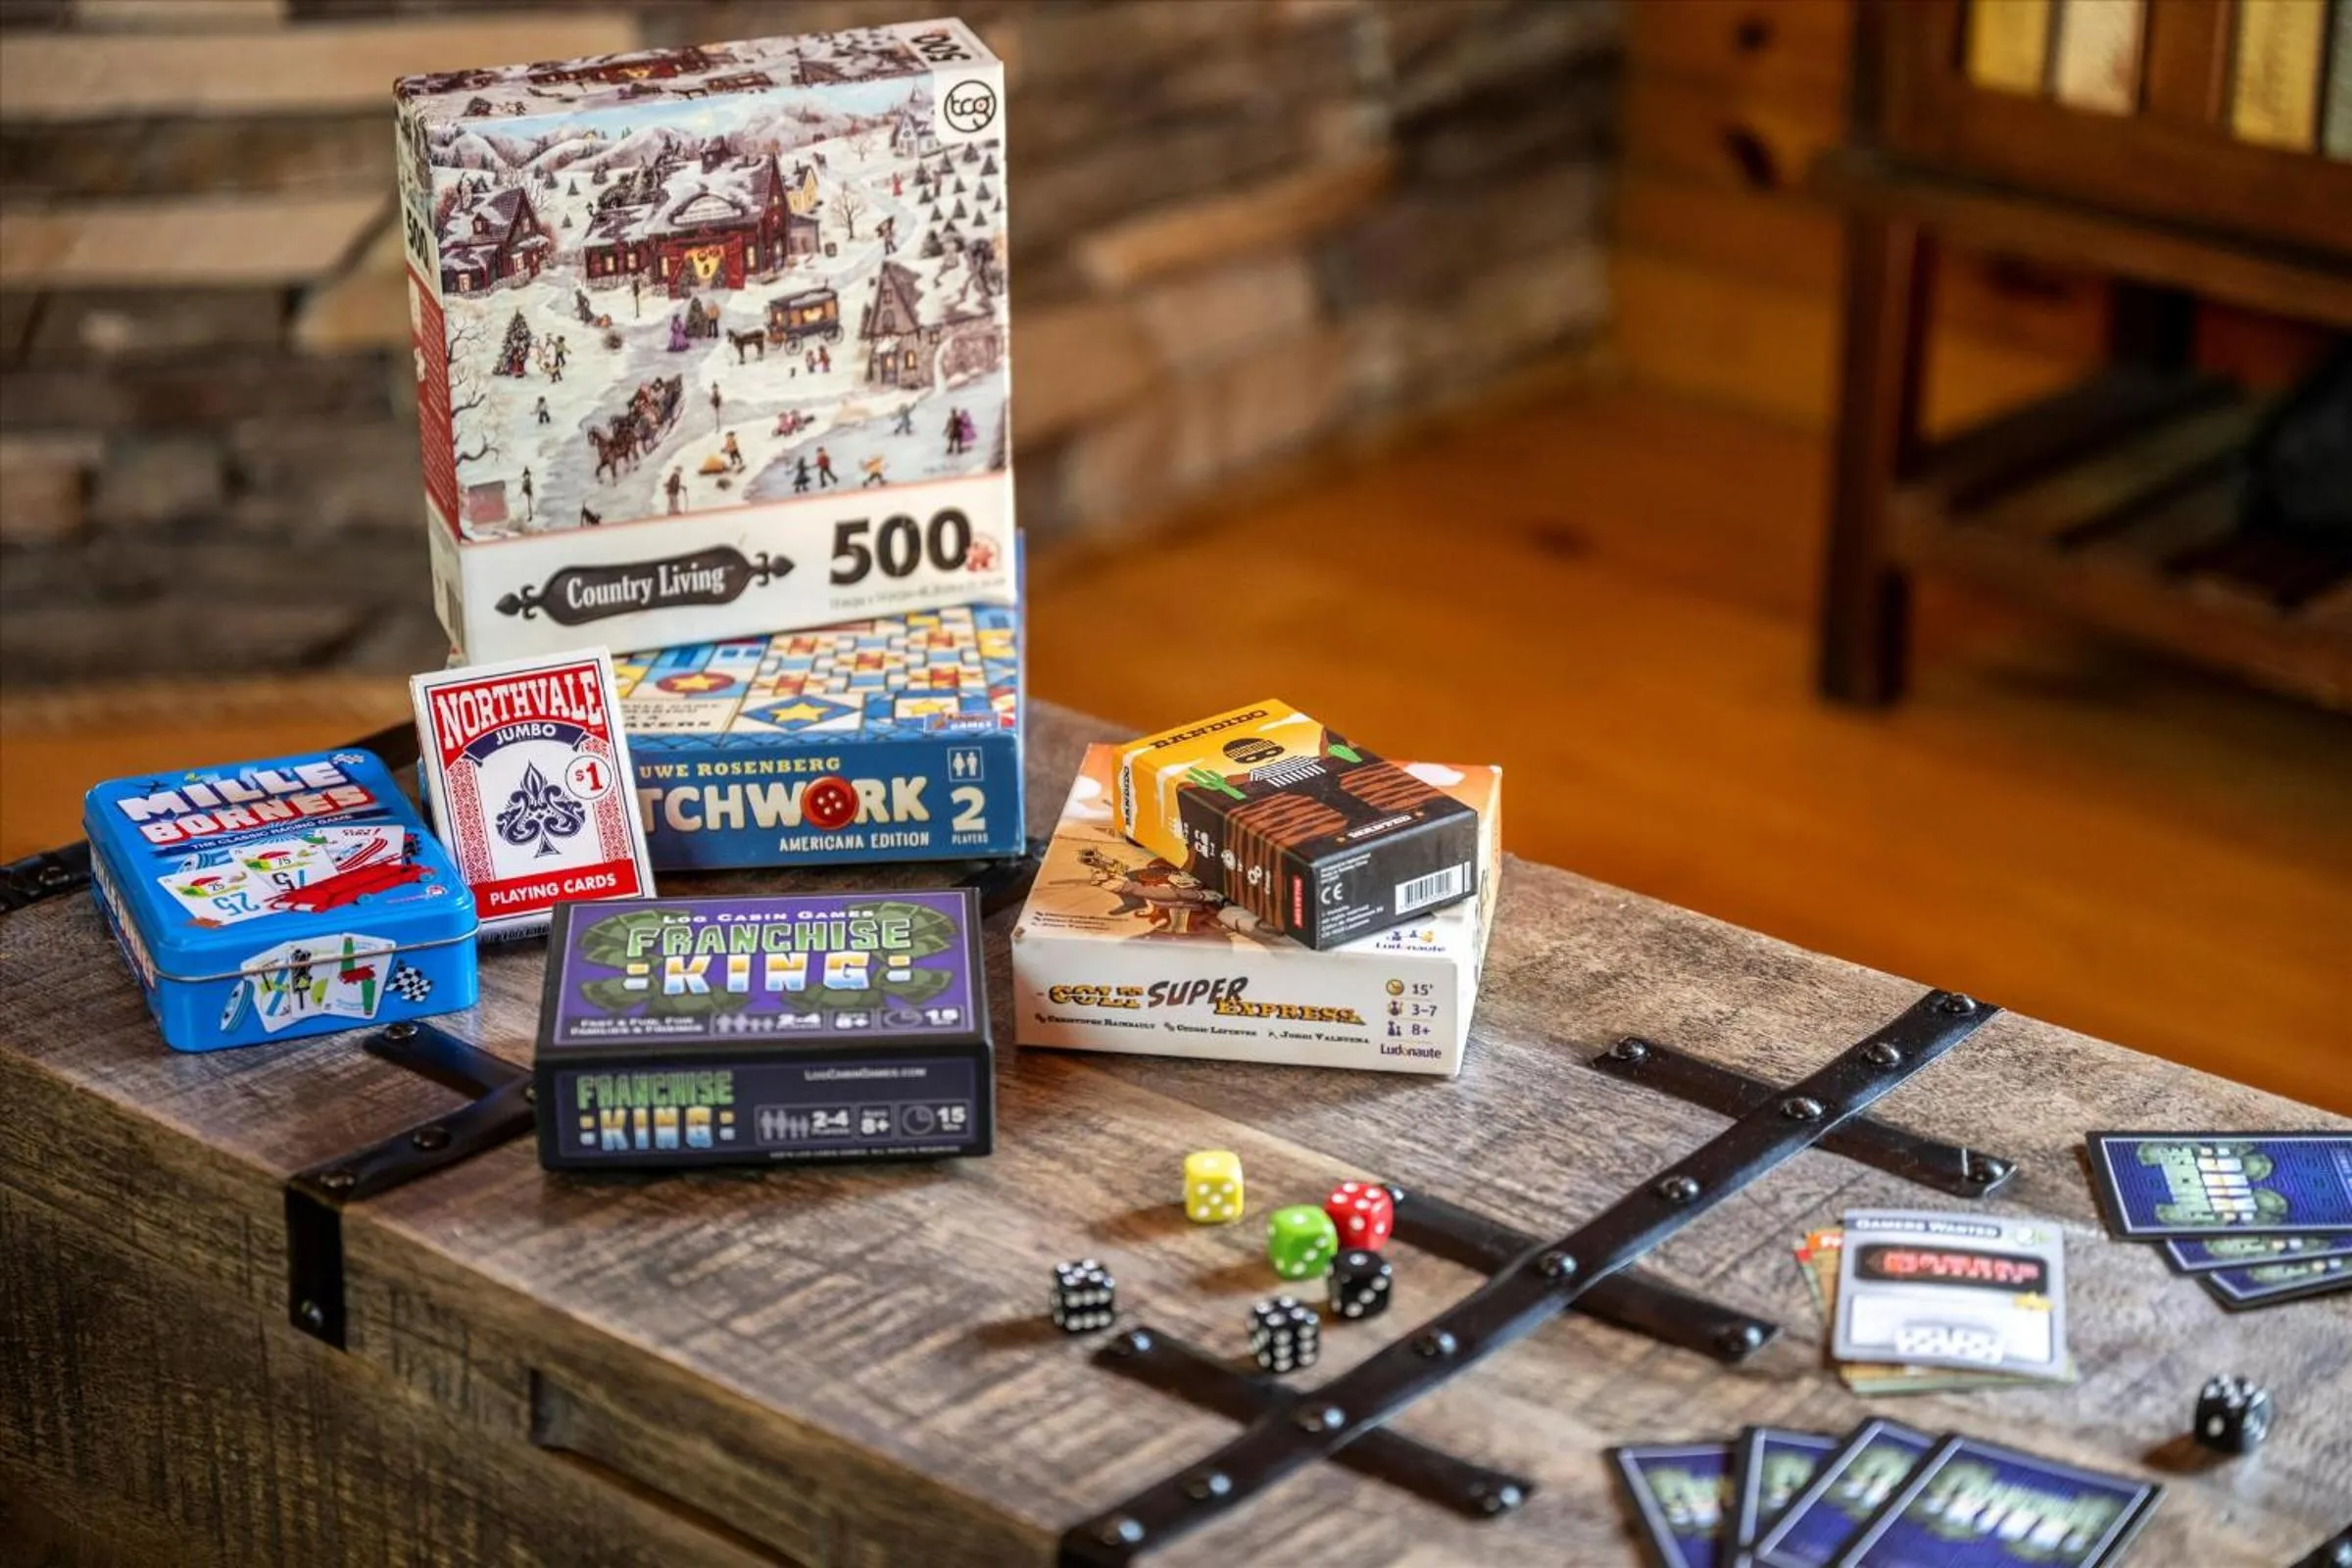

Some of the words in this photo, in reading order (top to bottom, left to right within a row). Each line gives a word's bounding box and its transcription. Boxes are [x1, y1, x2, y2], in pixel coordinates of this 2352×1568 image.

[910, 34, 971, 62] 500
[829, 506, 972, 586] 500
[566, 575, 653, 609] Country
[658, 562, 725, 596] Living
[436, 670, 604, 750] NORTHVALE
[496, 723, 557, 746] JUMBO
[574, 761, 605, 792] $1
[639, 763, 689, 778] UWE
[697, 757, 841, 777] ROSENBERG
[117, 760, 348, 821] MILLE
[139, 784, 368, 845] BORNES
[950, 786, 987, 832] 2
[192, 841, 218, 850] THE
[221, 831, 270, 846] CLASSIC
[270, 821, 317, 835] RACING
[779, 835, 864, 853] AMERICANA
[871, 831, 930, 849] EDITION
[951, 834, 989, 845] PLAYERS
[490, 882, 560, 906] PLAYING
[564, 872, 616, 894] CARDS
[663, 914, 708, 925] LOG
[717, 912, 788, 923] CABIN
[798, 909, 874, 920] GAMES
[626, 918, 912, 957] FRANCHISE
[1049, 984, 1146, 1009] COLT
[1148, 976, 1250, 1008] SUPER
[1213, 998, 1364, 1026] EXPRESS
[1411, 1023, 1431, 1036] 8+
[577, 1070, 735, 1110] FRANCHISE
[811, 1110, 850, 1128] 2-4
[860, 1118, 890, 1135] 8+
[937, 1105, 966, 1123] 15
